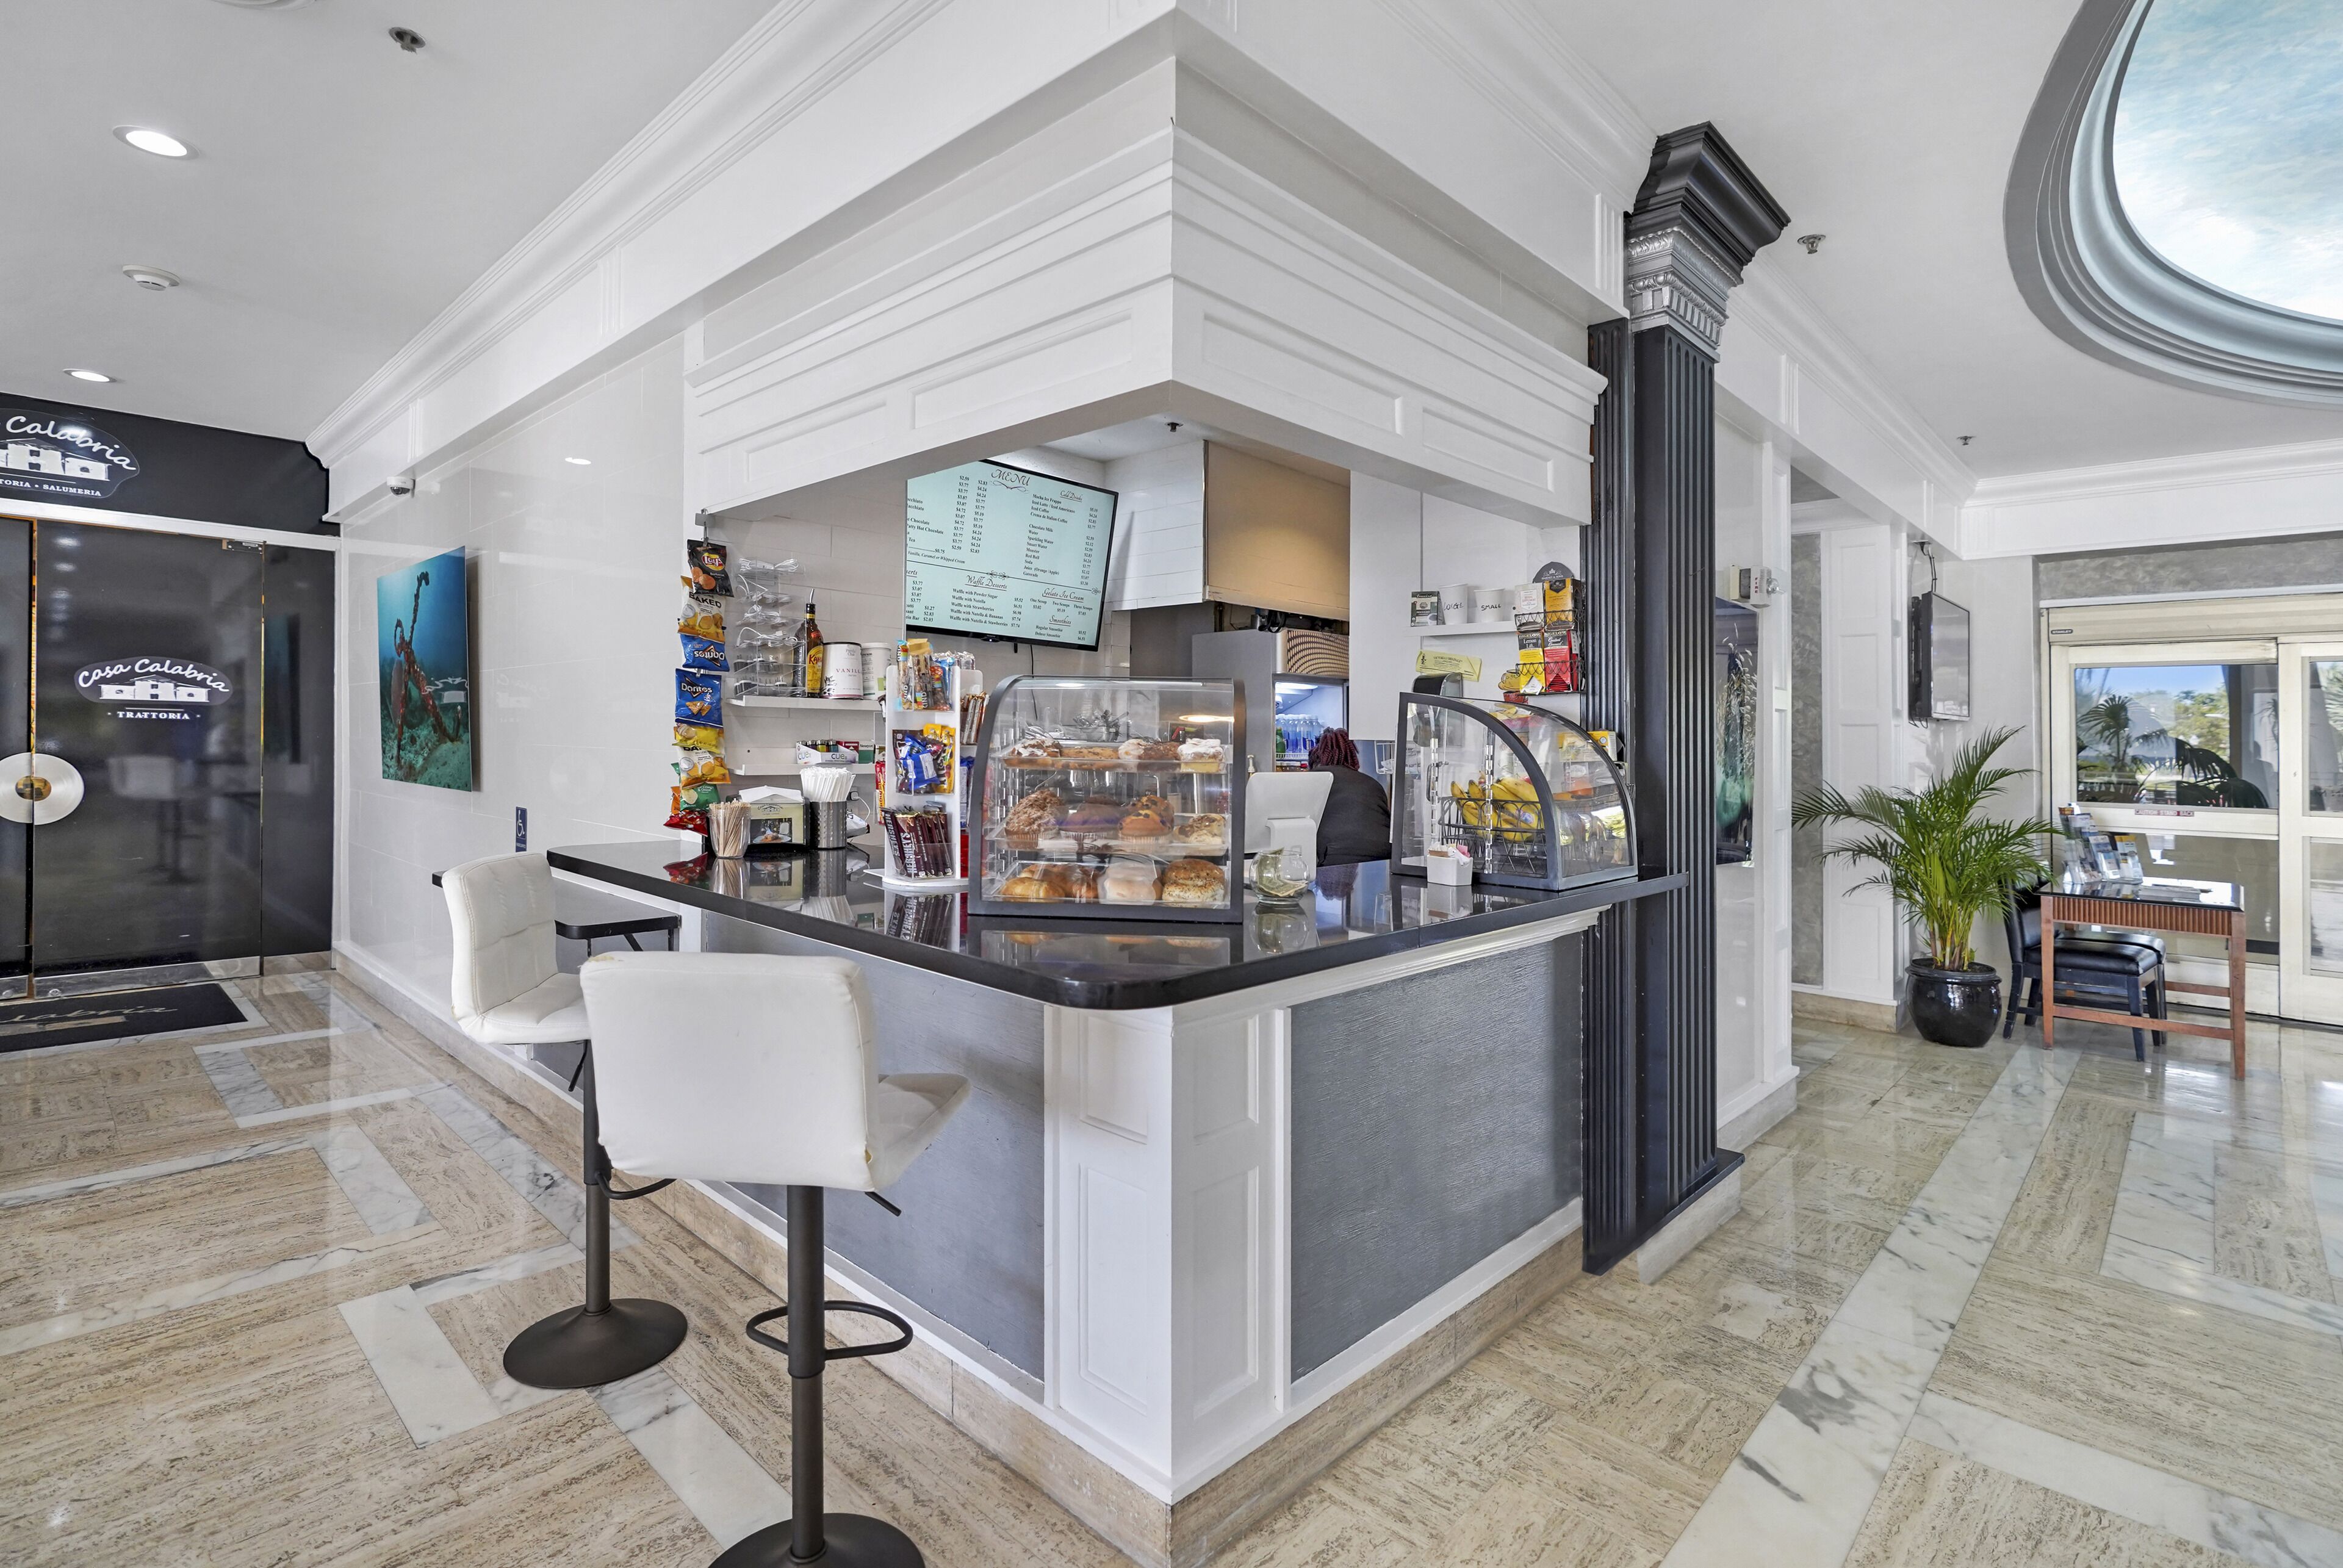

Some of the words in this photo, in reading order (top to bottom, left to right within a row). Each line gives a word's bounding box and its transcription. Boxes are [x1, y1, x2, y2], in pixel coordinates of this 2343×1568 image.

[6, 415, 136, 470] Calabria
[992, 469, 1030, 486] MENU
[43, 484, 102, 496] SALUMERIA
[705, 555, 722, 566] Lay's
[966, 575, 984, 586] Waffle
[985, 579, 1007, 589] Desserts
[689, 592, 722, 608] BAKED
[1042, 588, 1058, 597] Gelato
[1070, 592, 1084, 600] Cream
[1049, 615, 1071, 624] Smoothies
[694, 650, 725, 660] Doritos
[78, 664, 131, 688] Casa
[134, 658, 230, 692] Calabria
[681, 683, 713, 693] Doritos
[117, 711, 190, 720] TRATTORIA
[901, 833, 916, 873] HERSHEY'S
